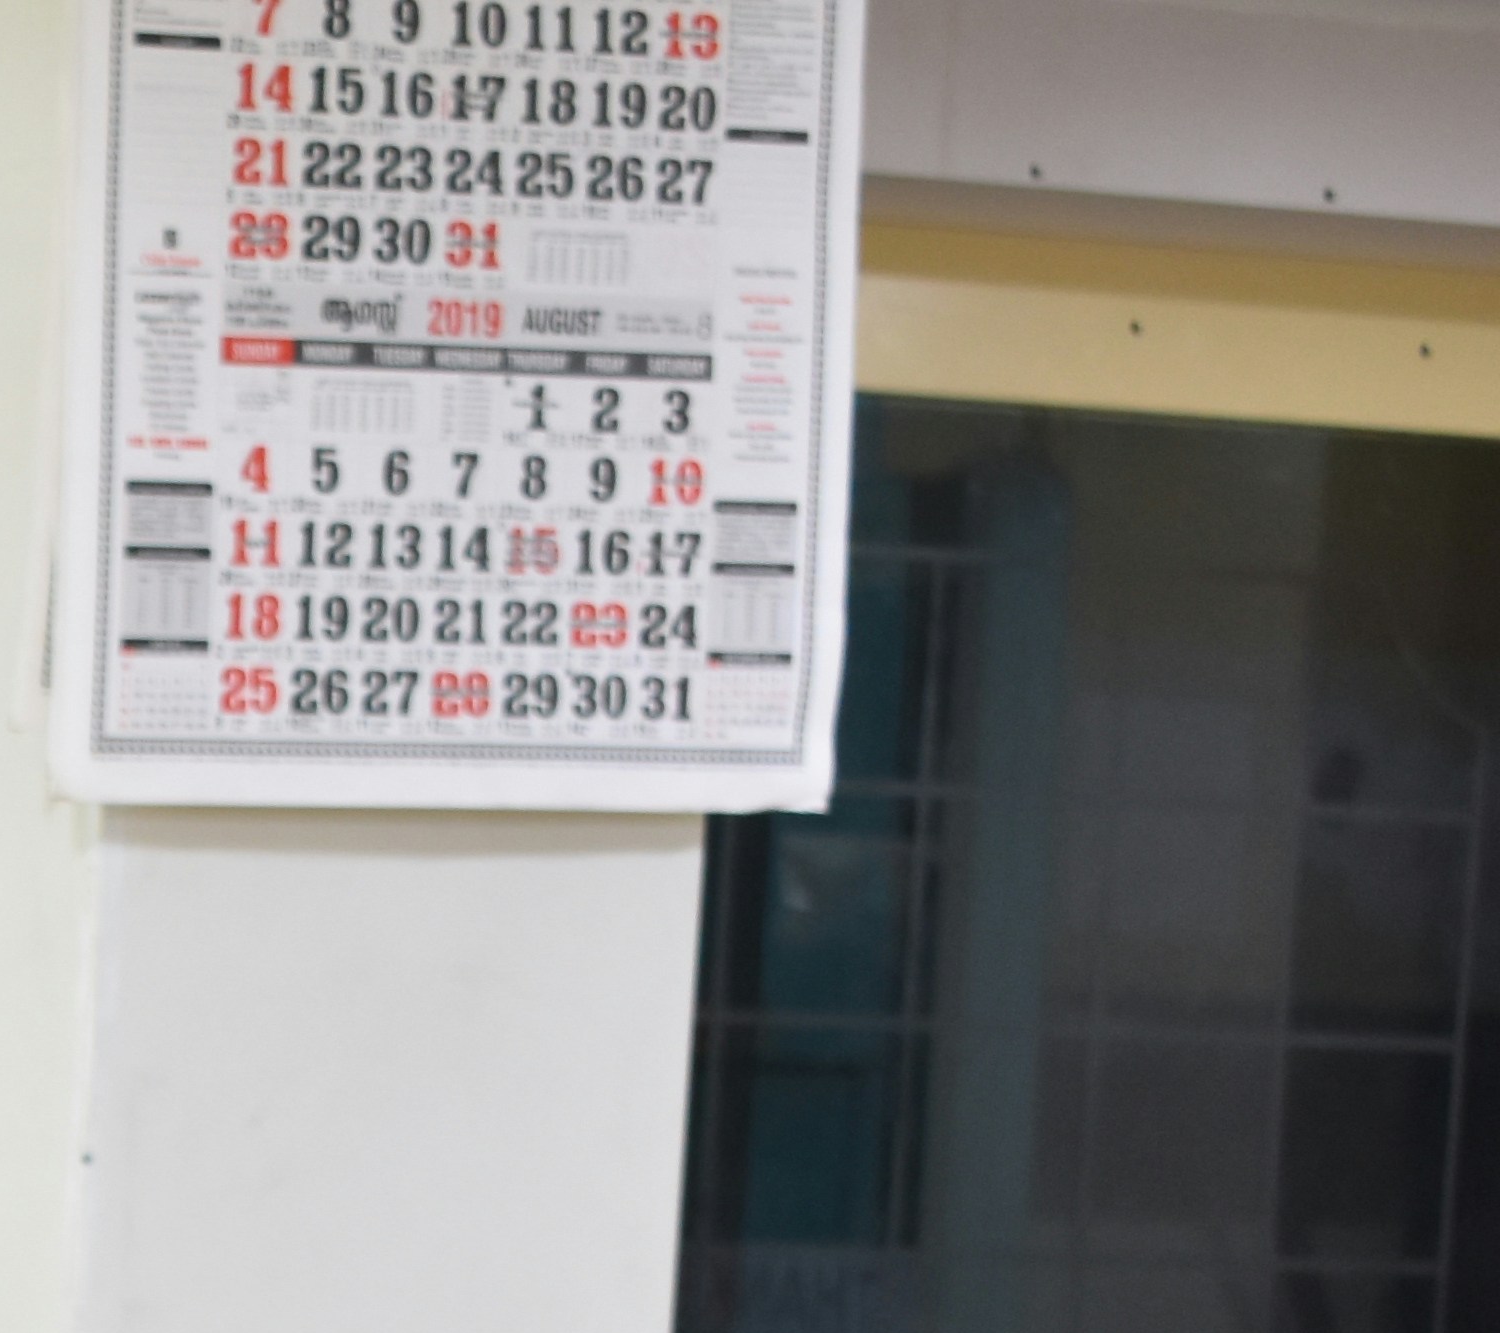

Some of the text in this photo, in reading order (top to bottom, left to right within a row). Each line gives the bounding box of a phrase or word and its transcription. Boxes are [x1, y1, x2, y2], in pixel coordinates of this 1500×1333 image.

[249, 0, 719, 60] 7 8 9 10 11 12 13
[238, 63, 716, 132] 14 15 16 17 18 19 20
[233, 137, 714, 204] 21 22 23 24 25 26 27
[229, 211, 499, 269] 28 29 30 31
[428, 299, 601, 337] 2019 AUGUST
[529, 386, 691, 433] 1 2 3
[242, 445, 702, 505] 4 5 6 7 8 9 10
[231, 520, 700, 575] 11 12 13 14 15 16 17
[227, 593, 696, 647] 18 19 20 21 22 23 24
[221, 668, 690, 719] 25 26 27 28 29 30 31
